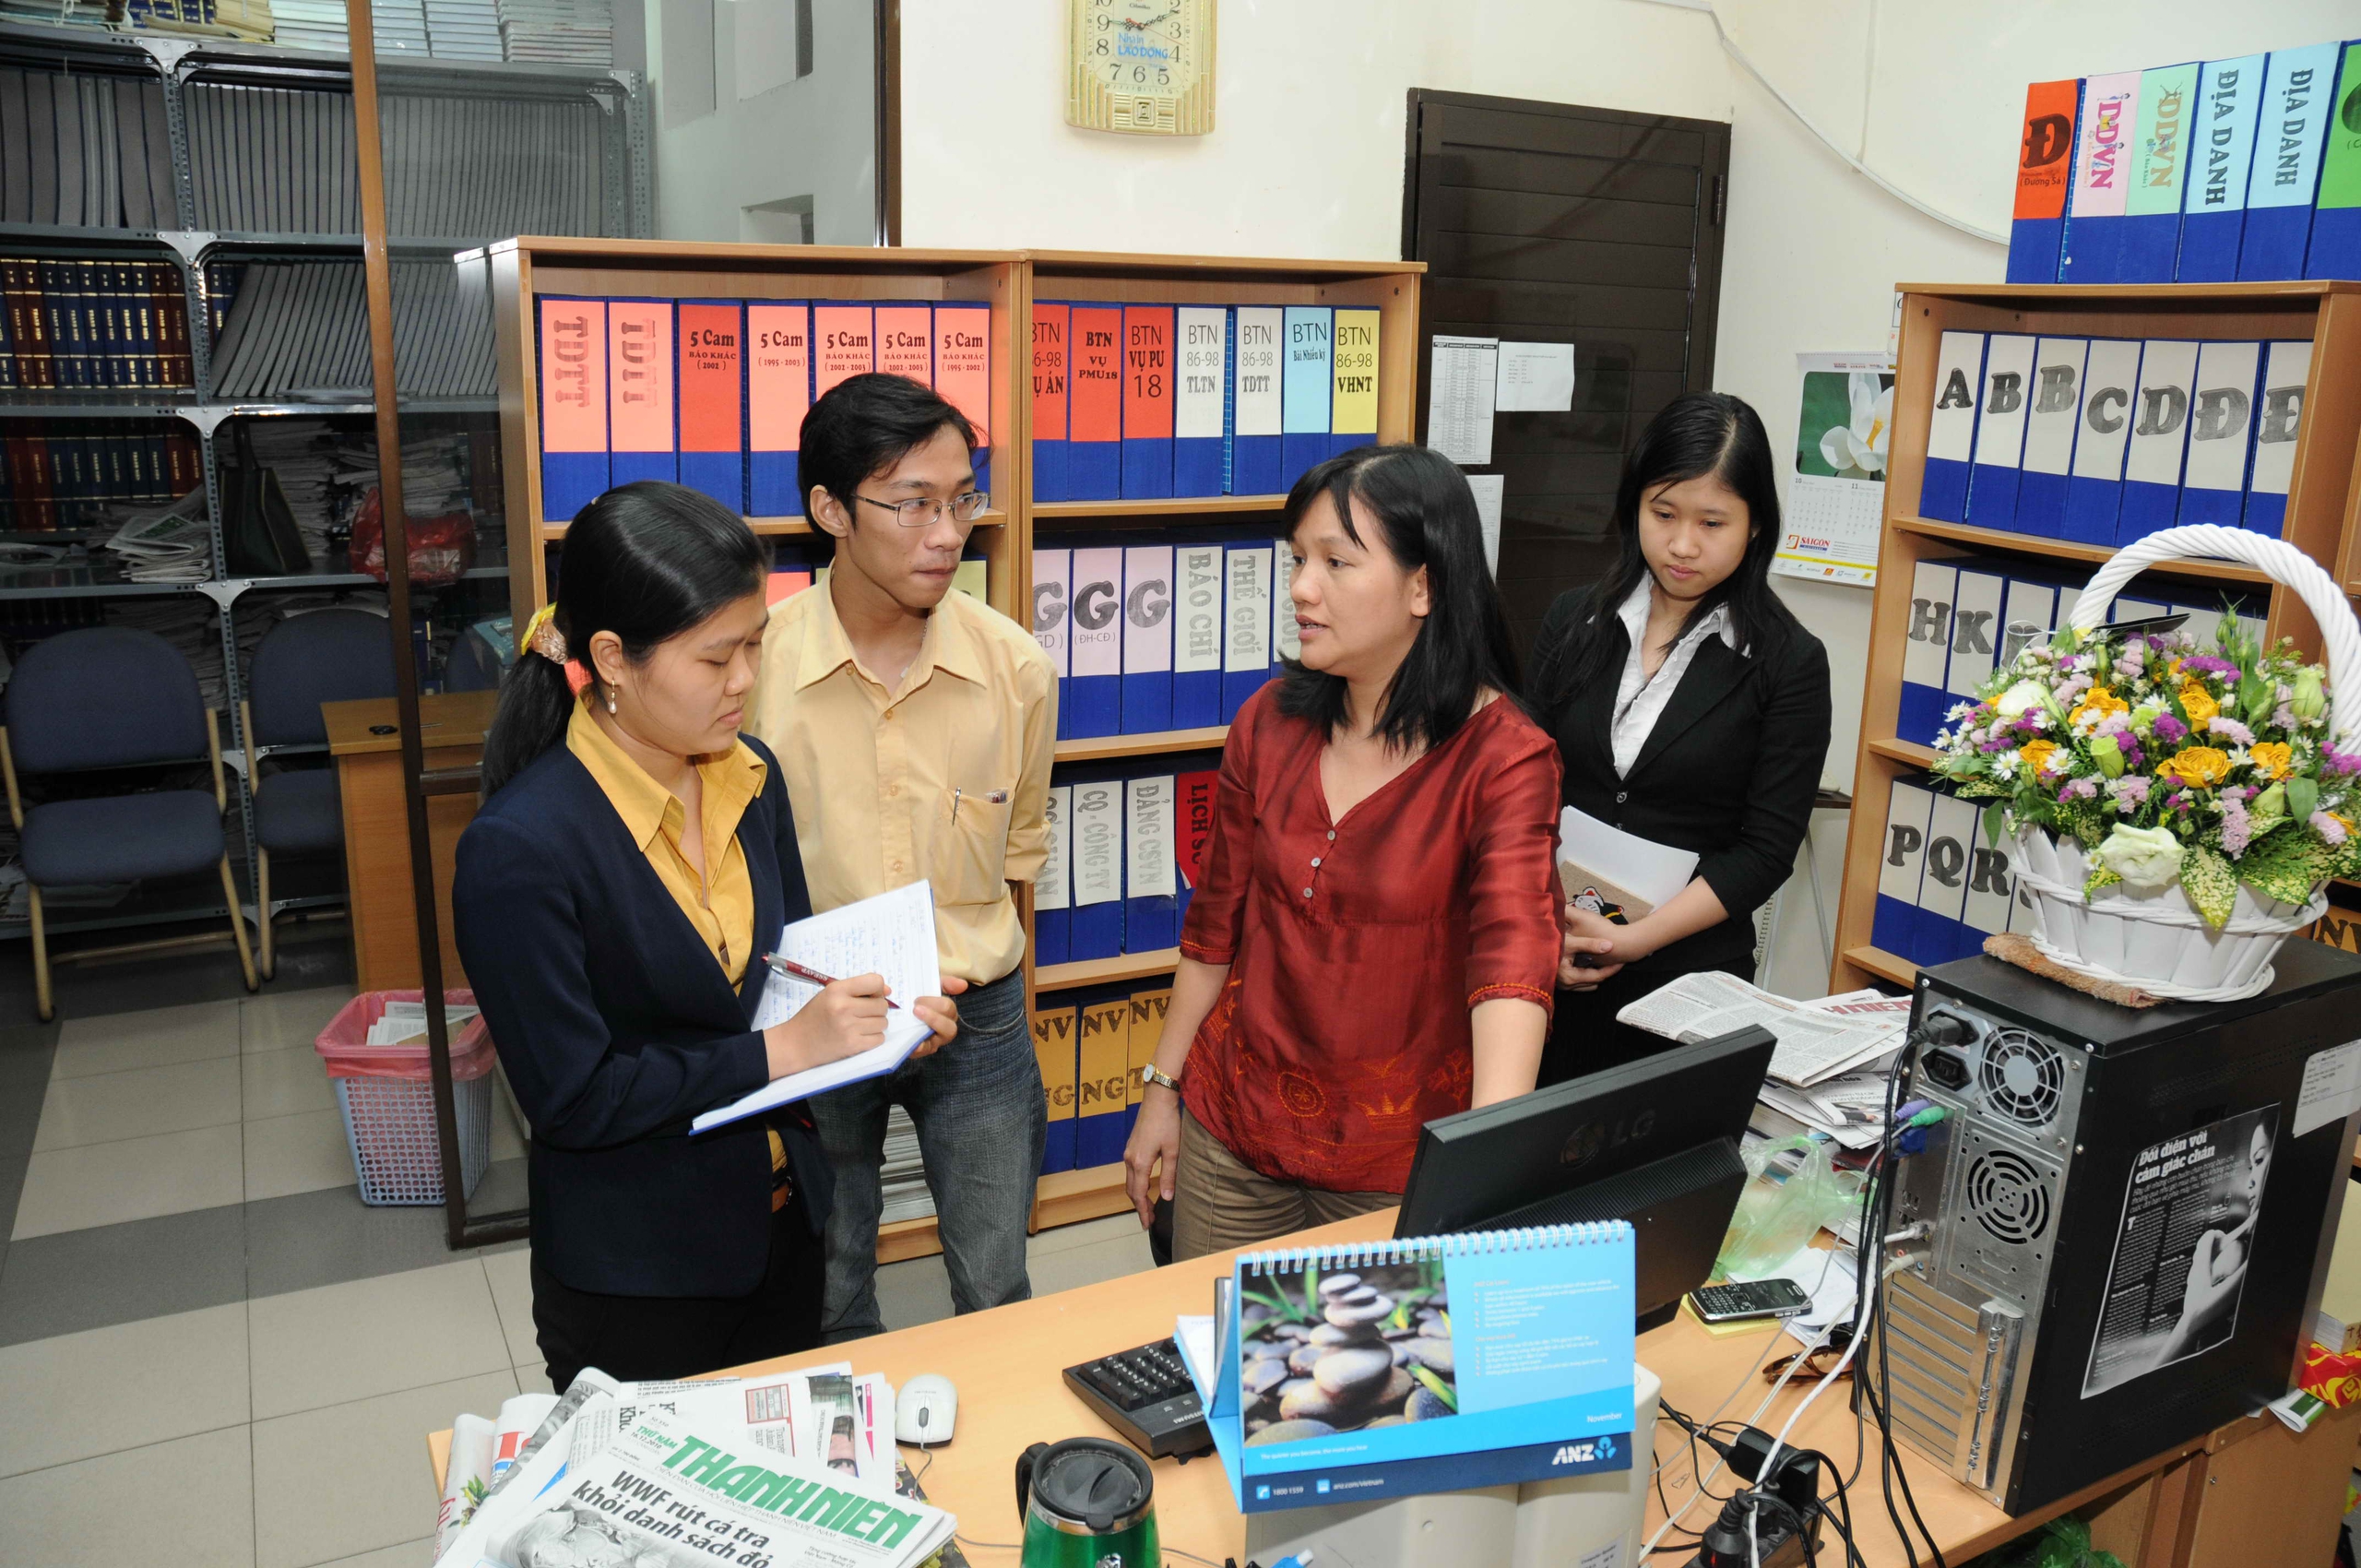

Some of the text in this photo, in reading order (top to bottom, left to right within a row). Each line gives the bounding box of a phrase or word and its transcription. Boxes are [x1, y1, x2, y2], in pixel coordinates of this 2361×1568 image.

[1097, 14, 1109, 31] 9
[1169, 22, 1181, 39] 3
[1096, 39, 1109, 55] 8
[1169, 46, 1181, 63] 4
[1109, 63, 1121, 80] 7
[1133, 66, 1145, 83] 6
[1157, 68, 1169, 85] 5
[2205, 68, 2240, 206] ĐỊA DANH
[2274, 67, 2314, 187] ĐỊA DANH
[2023, 113, 2071, 169] Đ
[689, 328, 735, 349] 5 Cam
[760, 330, 803, 349] 5 Cam
[826, 331, 869, 349] 5 Cam
[885, 331, 926, 349] 5 Cam
[943, 331, 984, 349] 5 Cam
[1086, 330, 1113, 348] BTN
[1131, 325, 1163, 346] BTN
[1188, 324, 1218, 346] BTN
[1242, 325, 1272, 346] BTN
[1292, 321, 1328, 344] BTN
[1337, 326, 1371, 347] BTN
[1032, 351, 1062, 368] 6-98
[1089, 356, 1107, 370] VỤ
[1129, 350, 1166, 374] VỤ PU
[1186, 351, 1220, 367] 86-98
[1241, 351, 1274, 367] 86-98
[1335, 353, 1372, 369] 86-98
[1078, 369, 1118, 381] PMU18
[1186, 375, 1216, 394] TLTN
[1241, 374, 1271, 393] TDTT
[1337, 375, 1372, 394] VHNT
[1134, 374, 1163, 399] 18
[1936, 367, 1974, 410] A
[1987, 371, 2023, 415] B
[2035, 363, 2077, 414] B
[2086, 386, 2129, 434] C
[2135, 385, 2188, 436] D
[2193, 387, 2250, 442] Đ
[1033, 581, 1068, 632] G
[1074, 580, 1120, 631] G
[1126, 578, 1171, 628] G
[1908, 598, 1951, 647] H
[1952, 610, 1994, 655] K
[1076, 790, 1109, 814] CQ
[1187, 783, 1208, 834] LỊCH
[1886, 824, 1922, 868] P
[1138, 838, 1164, 885] CSVN
[1928, 835, 1964, 888] Q
[1970, 847, 2011, 897] R
[1085, 869, 1110, 890] TY
[1082, 1008, 1127, 1039] NV
[1081, 1075, 1127, 1105] NG
[1586, 1411, 1623, 1423] November
[654, 1433, 679, 1450] NĂM
[1551, 1443, 1596, 1466] ANZ
[661, 1434, 823, 1518] THANH
[571, 1479, 632, 1515] khỏi
[623, 1507, 684, 1540] danh
[681, 1534, 737, 1561] sách
[611, 1469, 771, 1550] WWF rút cá tra
